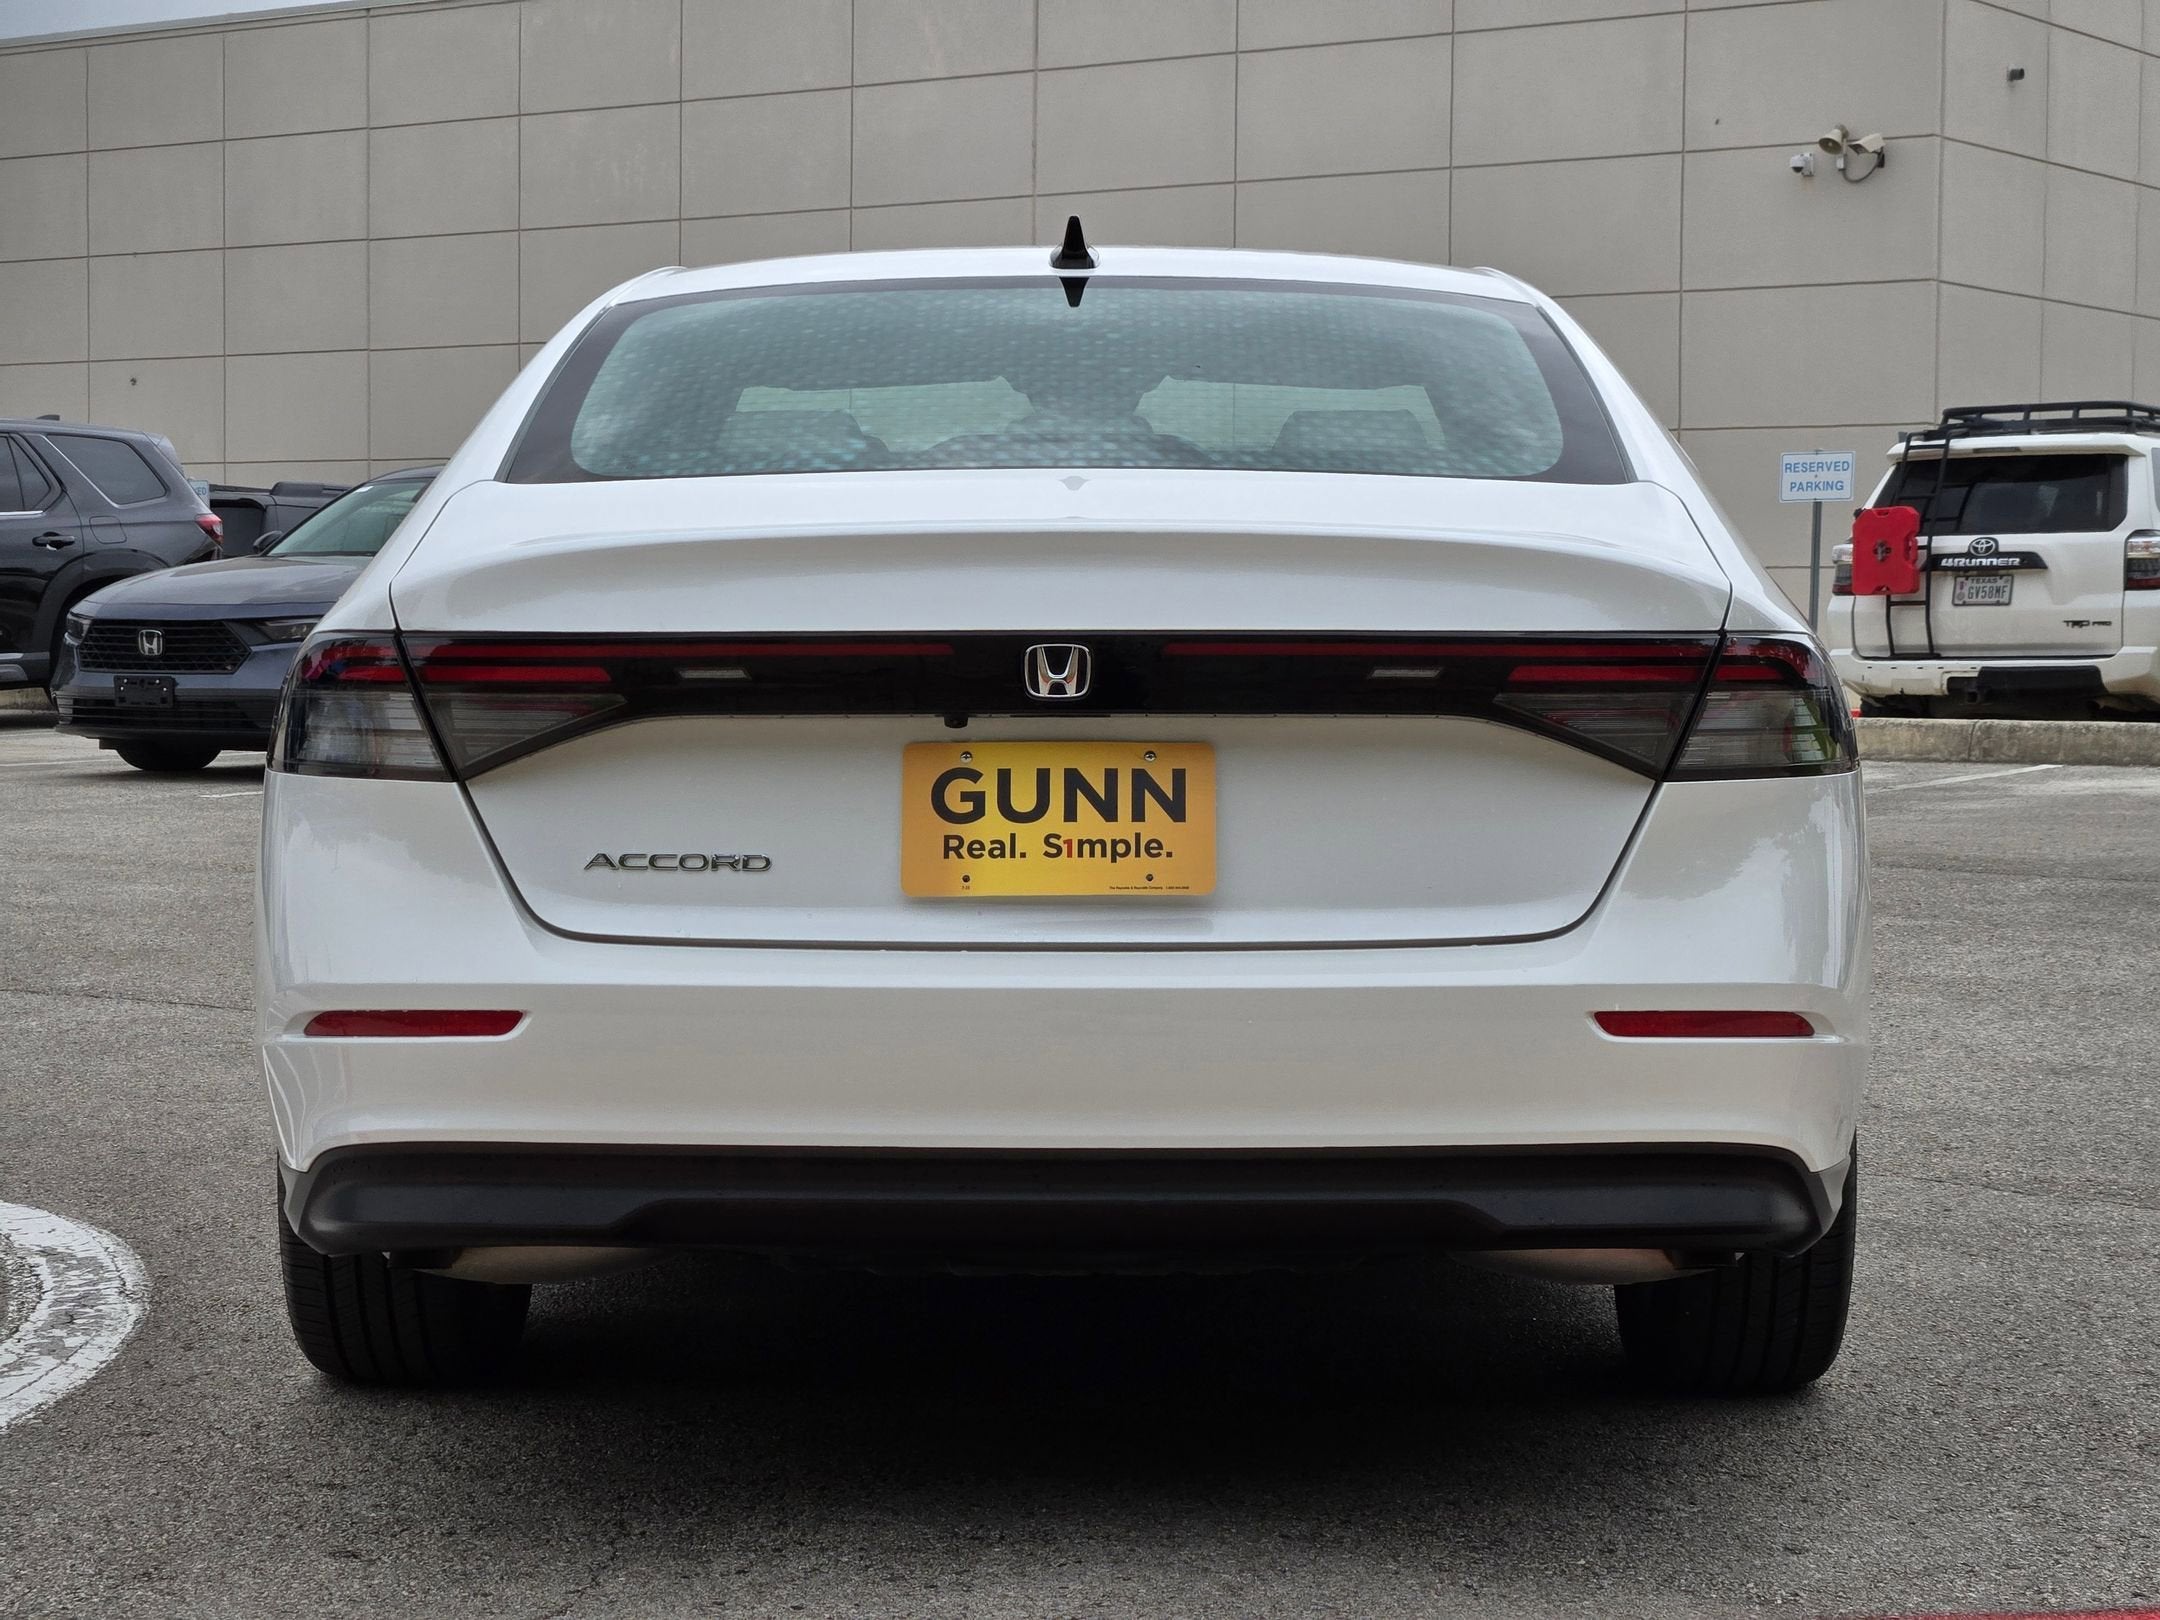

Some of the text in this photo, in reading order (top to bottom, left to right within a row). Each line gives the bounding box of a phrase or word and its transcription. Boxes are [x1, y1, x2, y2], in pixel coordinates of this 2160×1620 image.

[1784, 460, 1850, 474] RESERVED
[1789, 480, 1845, 492] PARKING
[1940, 557, 2021, 567] 4RUNNER
[931, 767, 1187, 825] GUNN
[943, 832, 1173, 863] Real. S1mple.
[584, 853, 772, 872] ACCORD
